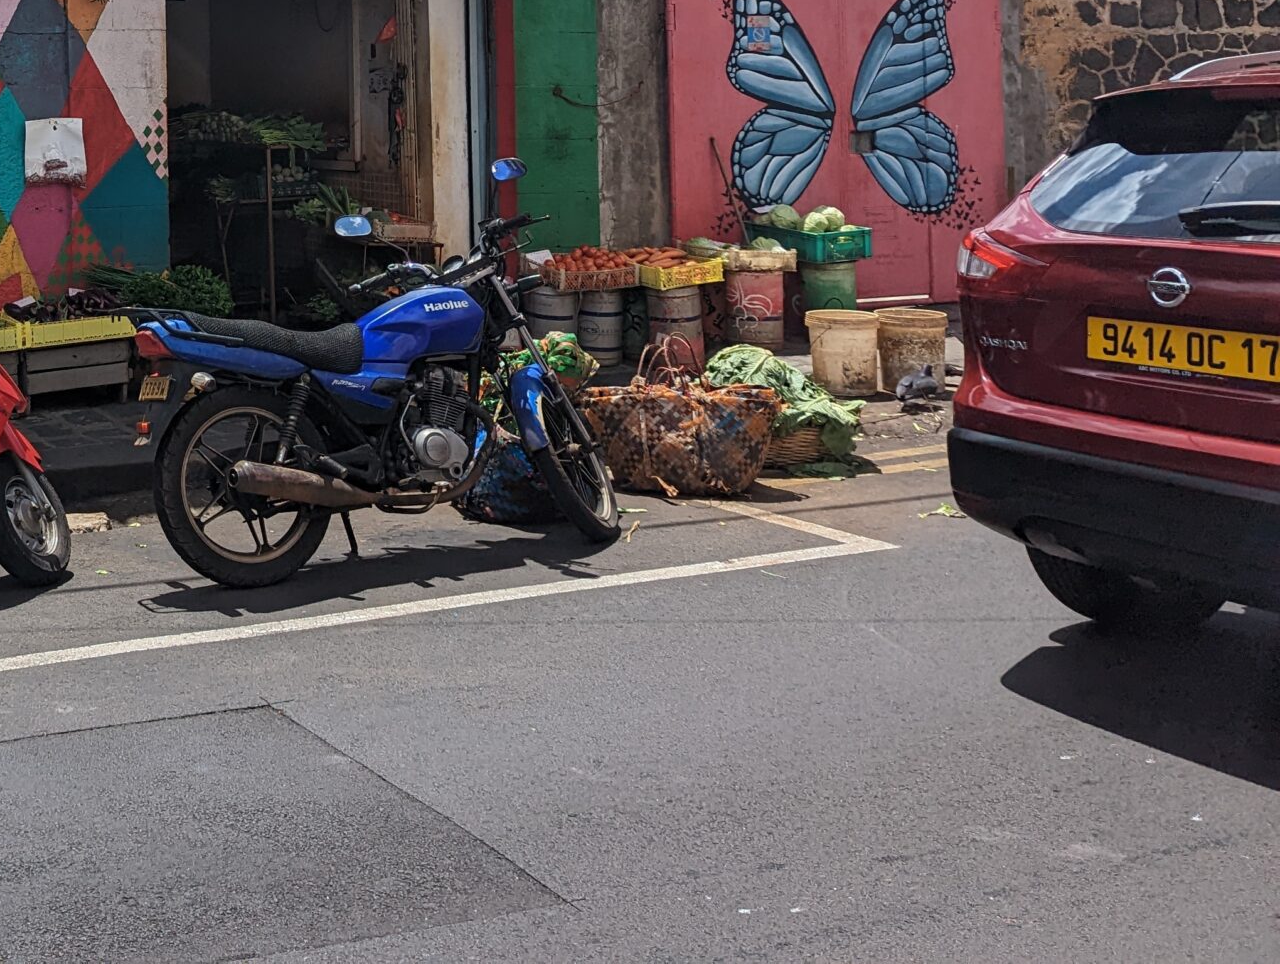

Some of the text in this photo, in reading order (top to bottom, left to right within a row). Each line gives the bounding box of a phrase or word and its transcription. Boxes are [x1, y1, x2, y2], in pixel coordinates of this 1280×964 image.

[423, 300, 469, 312] HaoJue
[1103, 323, 1176, 363] 9414
[1241, 338, 1279, 376] 17
